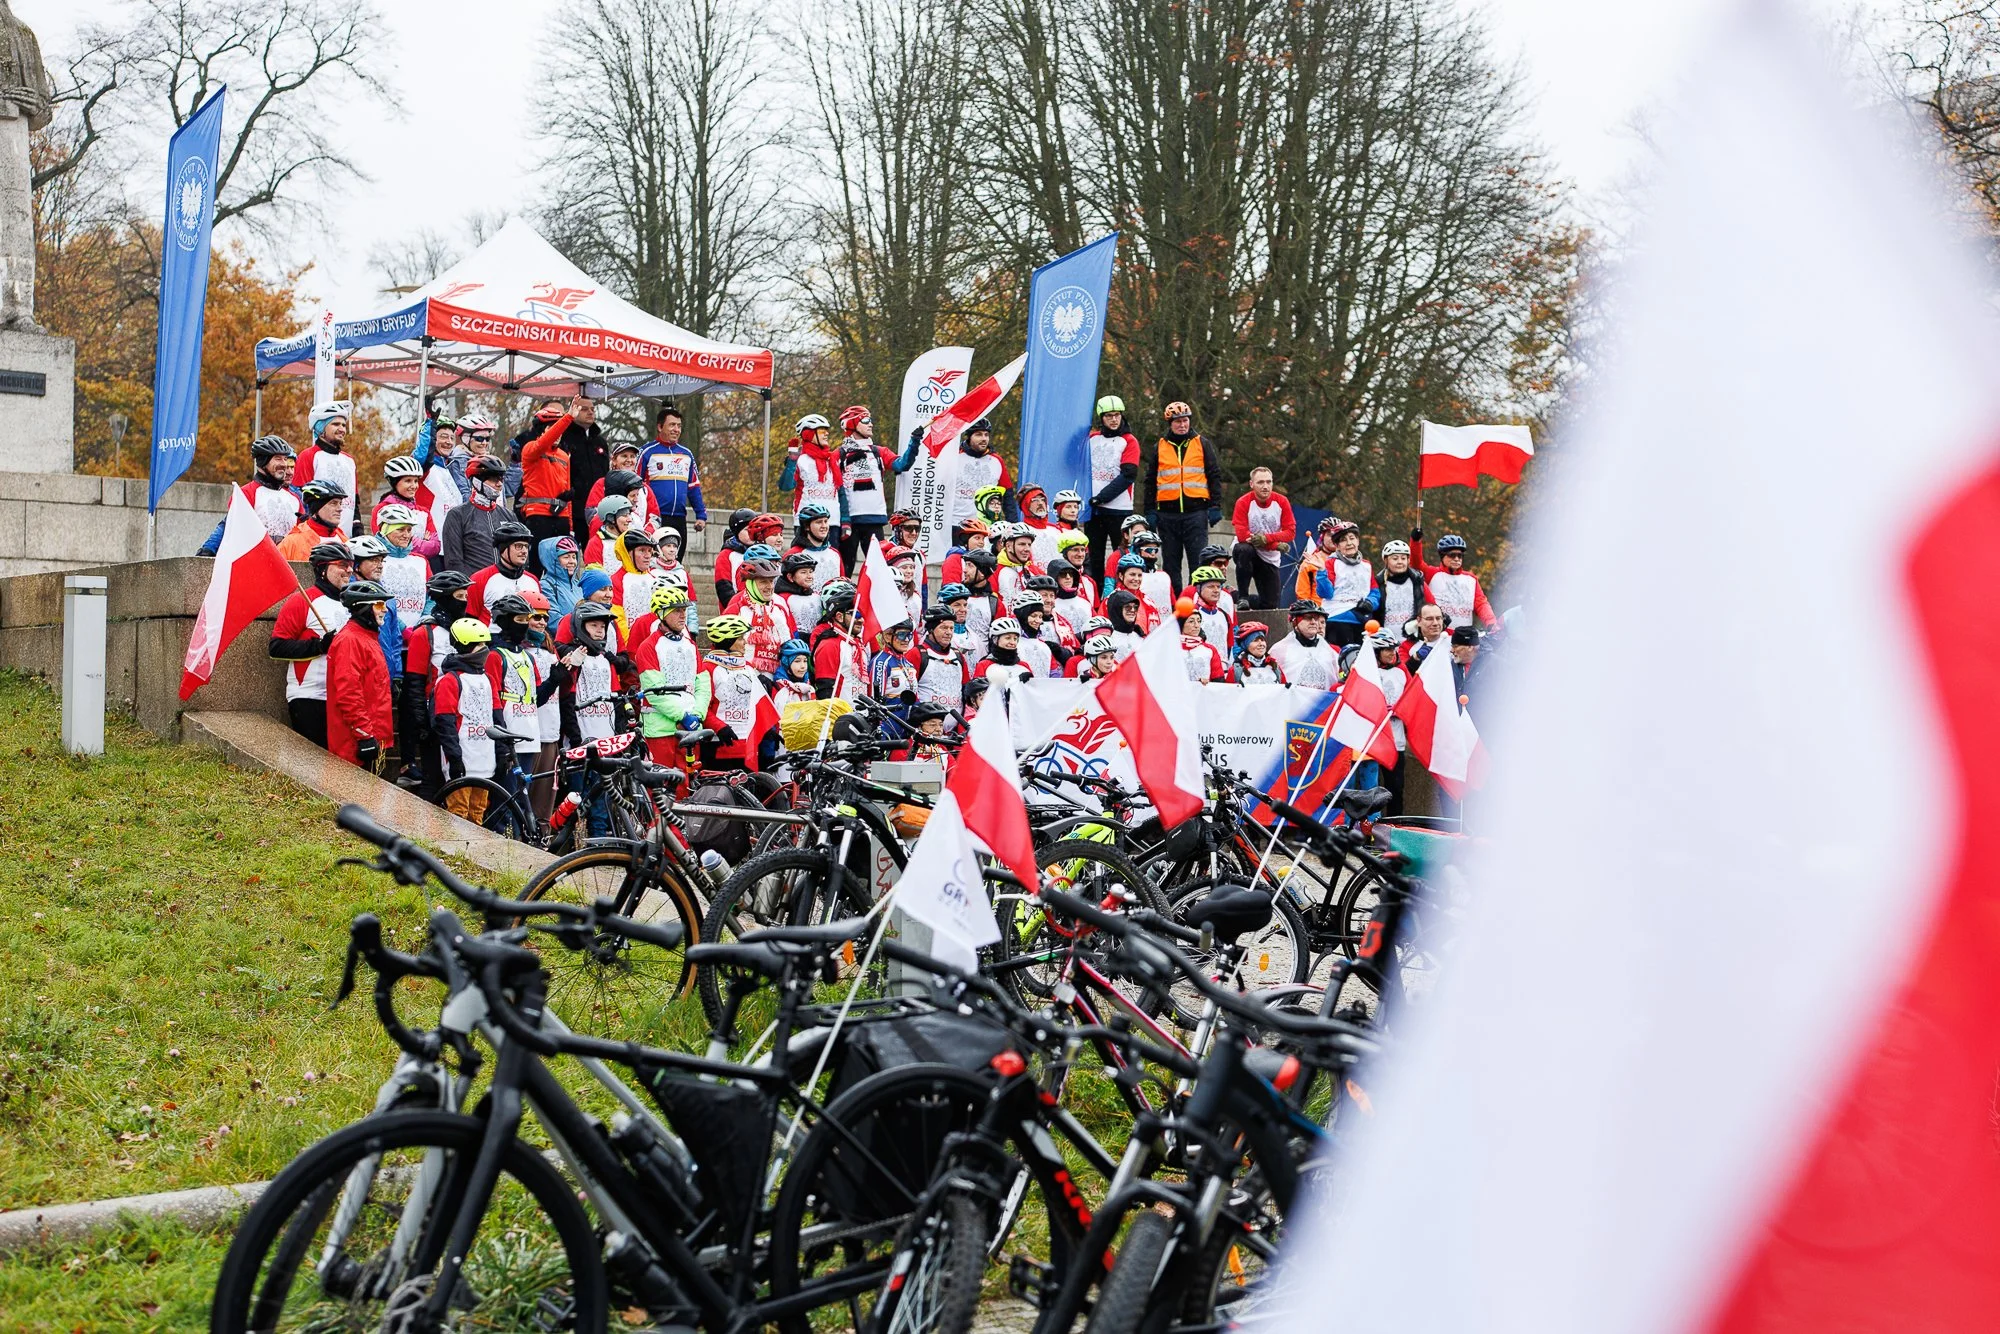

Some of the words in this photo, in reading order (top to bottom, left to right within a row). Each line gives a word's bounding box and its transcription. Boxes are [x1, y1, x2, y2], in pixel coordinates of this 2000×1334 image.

[1043, 290, 1073, 328] INSTYTUT
[335, 319, 380, 339] ROWEROWY
[381, 312, 417, 332] GRYFUS
[450, 314, 555, 343] SZCZECIŃSKI
[559, 330, 600, 348] KLUB
[604, 335, 695, 365] ROWEROWY
[697, 352, 755, 374] GRYFUS
[1045, 333, 1088, 354] NARODOWEJ
[916, 403, 949, 414] GRYF
[934, 484, 946, 531] GRYFUS
[1197, 733, 1215, 744] lub
[1217, 733, 1274, 748] Rowerowy
[680, 851, 716, 898] LYNSK
